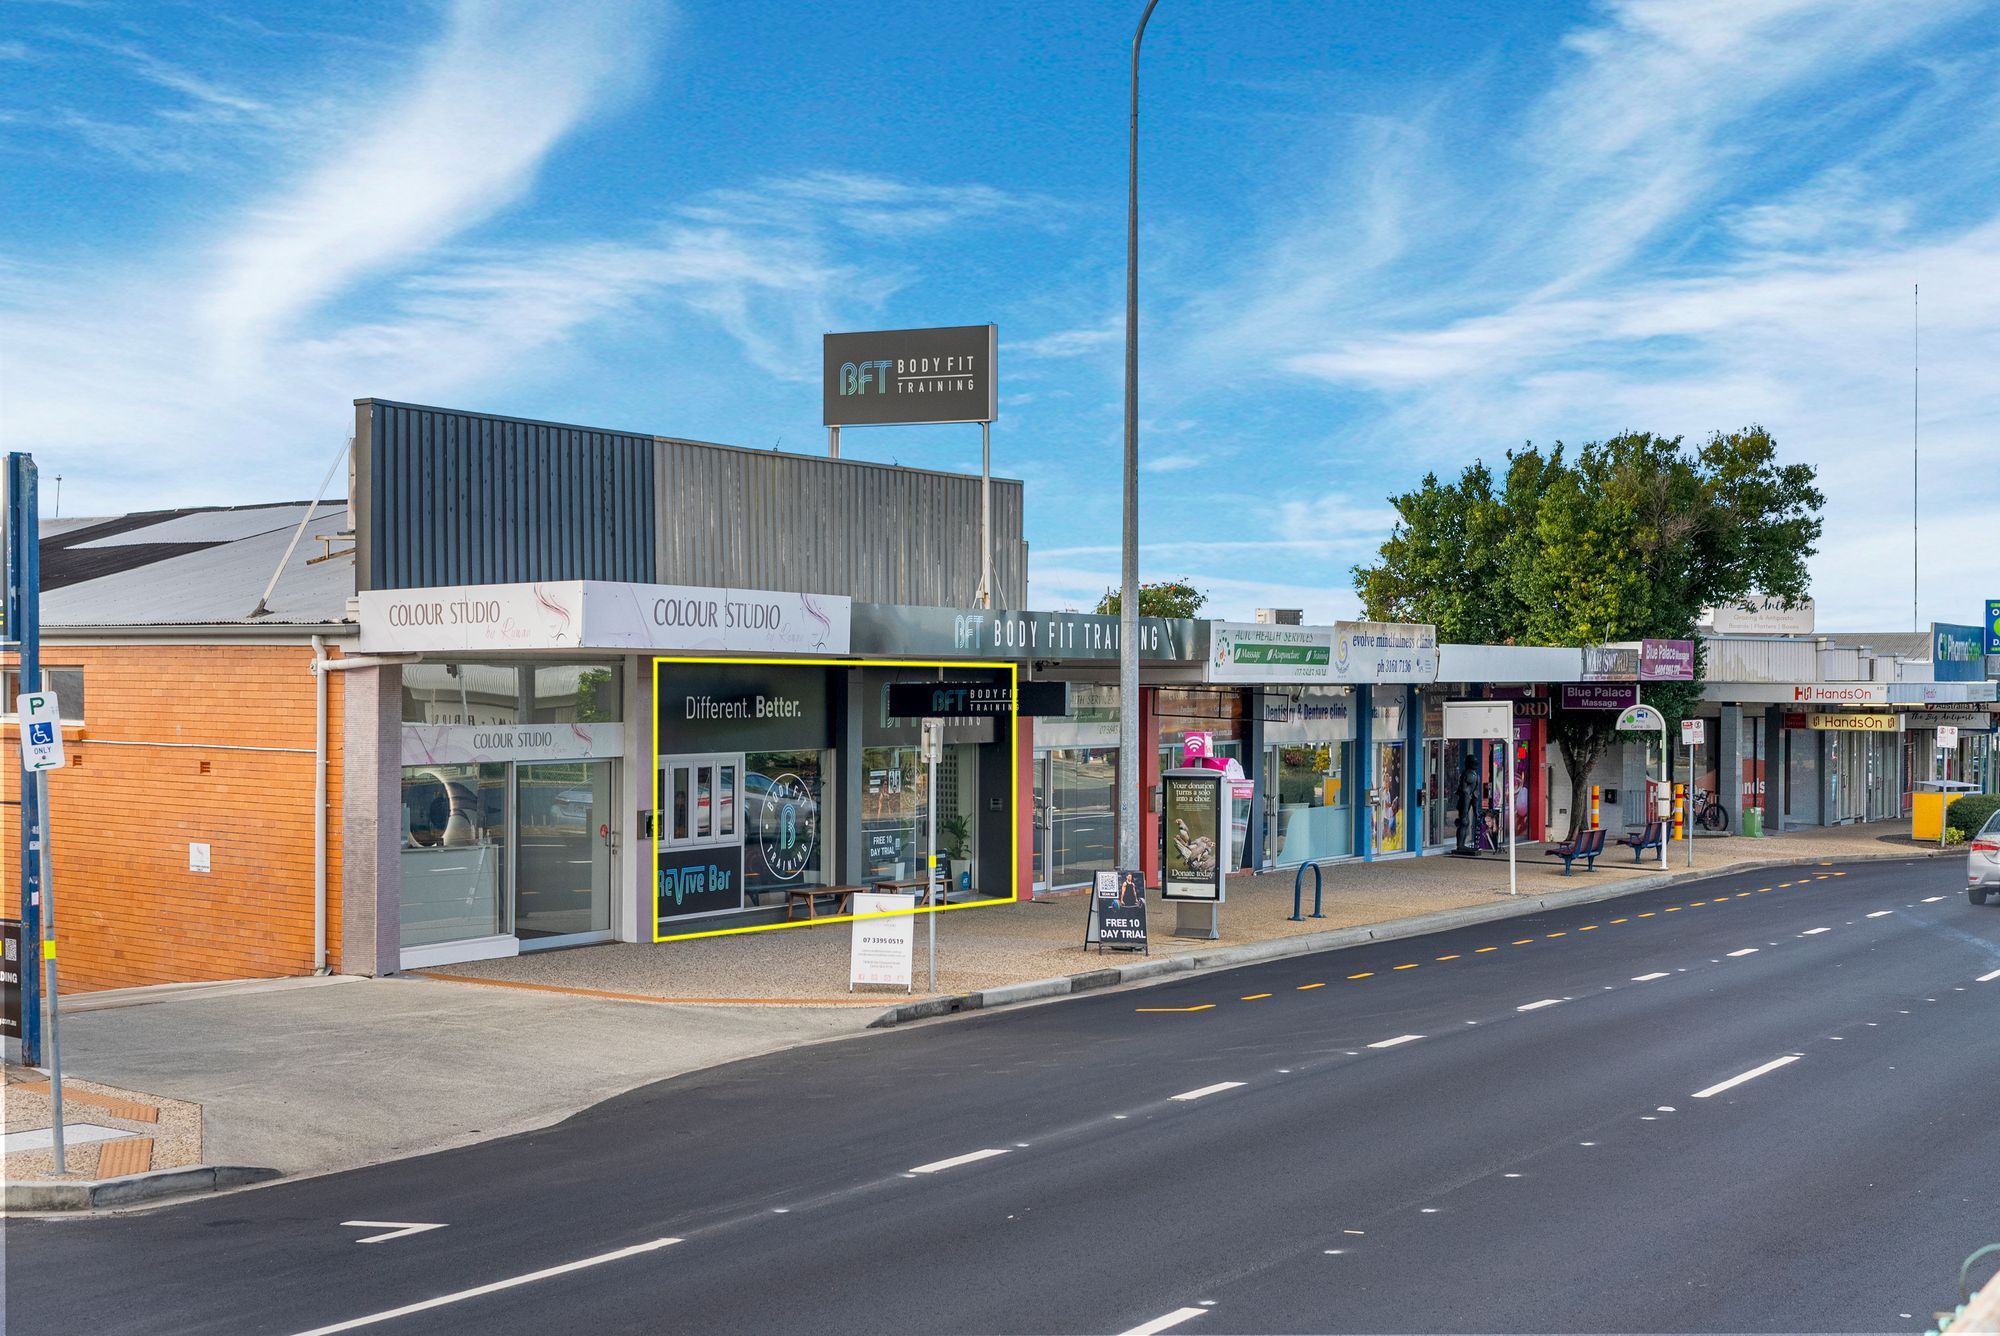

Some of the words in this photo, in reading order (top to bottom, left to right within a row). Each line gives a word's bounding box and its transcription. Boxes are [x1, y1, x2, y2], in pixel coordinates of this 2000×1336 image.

[840, 360, 892, 396] BFT
[898, 358, 940, 374] BODY
[947, 356, 974, 372] FIT
[898, 379, 974, 394] TRAINING
[389, 602, 444, 627] COLOUR
[450, 600, 500, 624] STUDIO
[1760, 598, 1812, 614] Antipsto.
[654, 598, 718, 628] COLOUR
[726, 602, 781, 630] STUDIO
[994, 620, 1038, 648] BODY
[1050, 622, 1074, 649] FIT
[1084, 623, 1158, 650] TRAING
[1256, 630, 1281, 642] HEALTH
[1284, 632, 1314, 643] SERVICES
[1352, 631, 1374, 648] evolve
[1376, 632, 1415, 648] mindfulness
[1416, 634, 1434, 648] clinic
[1646, 644, 1658, 660] Blue
[1659, 645, 1676, 660] Palace
[1376, 659, 1384, 677] ph
[970, 689, 998, 700] BODY
[1567, 687, 1592, 697] Blue
[1594, 687, 1632, 698] Palace
[1816, 688, 1872, 700] HandsOn
[30, 696, 44, 715] P
[686, 696, 751, 720] Different.
[756, 696, 801, 718] Better.
[1513, 702, 1548, 716] ORD
[1266, 704, 1296, 724] Dentisry
[1297, 704, 1304, 720] &
[1304, 704, 1328, 720] Denture
[1330, 704, 1347, 720] clinic
[1824, 716, 1883, 728] HandsOn
[474, 732, 513, 750] COLOUR
[518, 731, 552, 748] STUDIO
[34, 746, 52, 755] ONLY
[1172, 782, 1188, 790] Your
[1188, 782, 1215, 790] donation
[767, 782, 790, 812] BODY
[792, 785, 807, 808] FIT
[873, 836, 886, 846] FREE
[886, 835, 892, 844] 10
[766, 843, 808, 871] TRAINING
[870, 847, 881, 857] DAY
[882, 846, 895, 856] TRIAL
[708, 864, 731, 892] Bar
[1172, 868, 1195, 877] Donate
[1196, 868, 1214, 878] today
[1106, 918, 1128, 928] FREE
[1129, 918, 1140, 928] 10
[1100, 930, 1119, 938] DAY
[1120, 930, 1146, 939] TRIAL
[0, 970, 18, 984] DING
